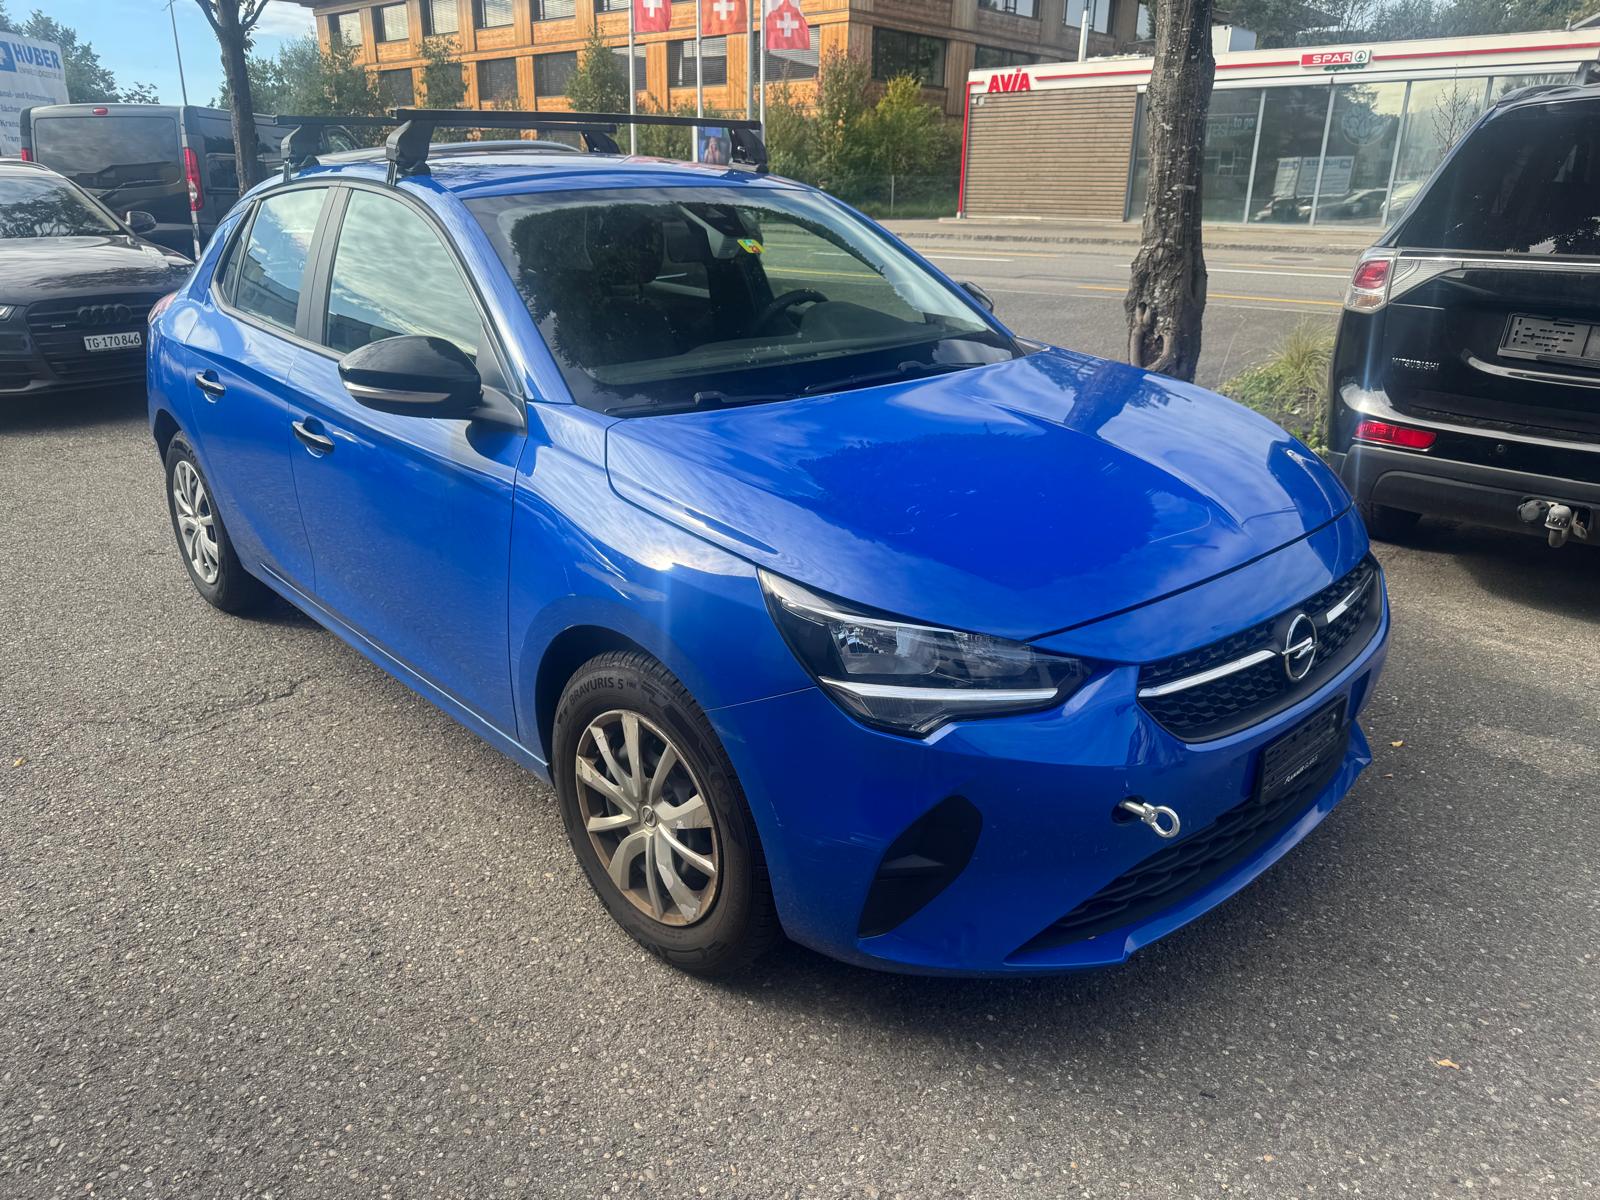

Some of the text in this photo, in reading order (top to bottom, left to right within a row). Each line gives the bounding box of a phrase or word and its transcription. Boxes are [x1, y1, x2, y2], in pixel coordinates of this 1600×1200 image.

[11, 42, 60, 69] HUBER
[1312, 52, 1352, 64] SPAR
[987, 67, 1031, 93] AVIA
[1392, 356, 1440, 372] MITSUBISHI
[569, 677, 615, 705] BRAVURIS
[617, 679, 624, 690] 5
